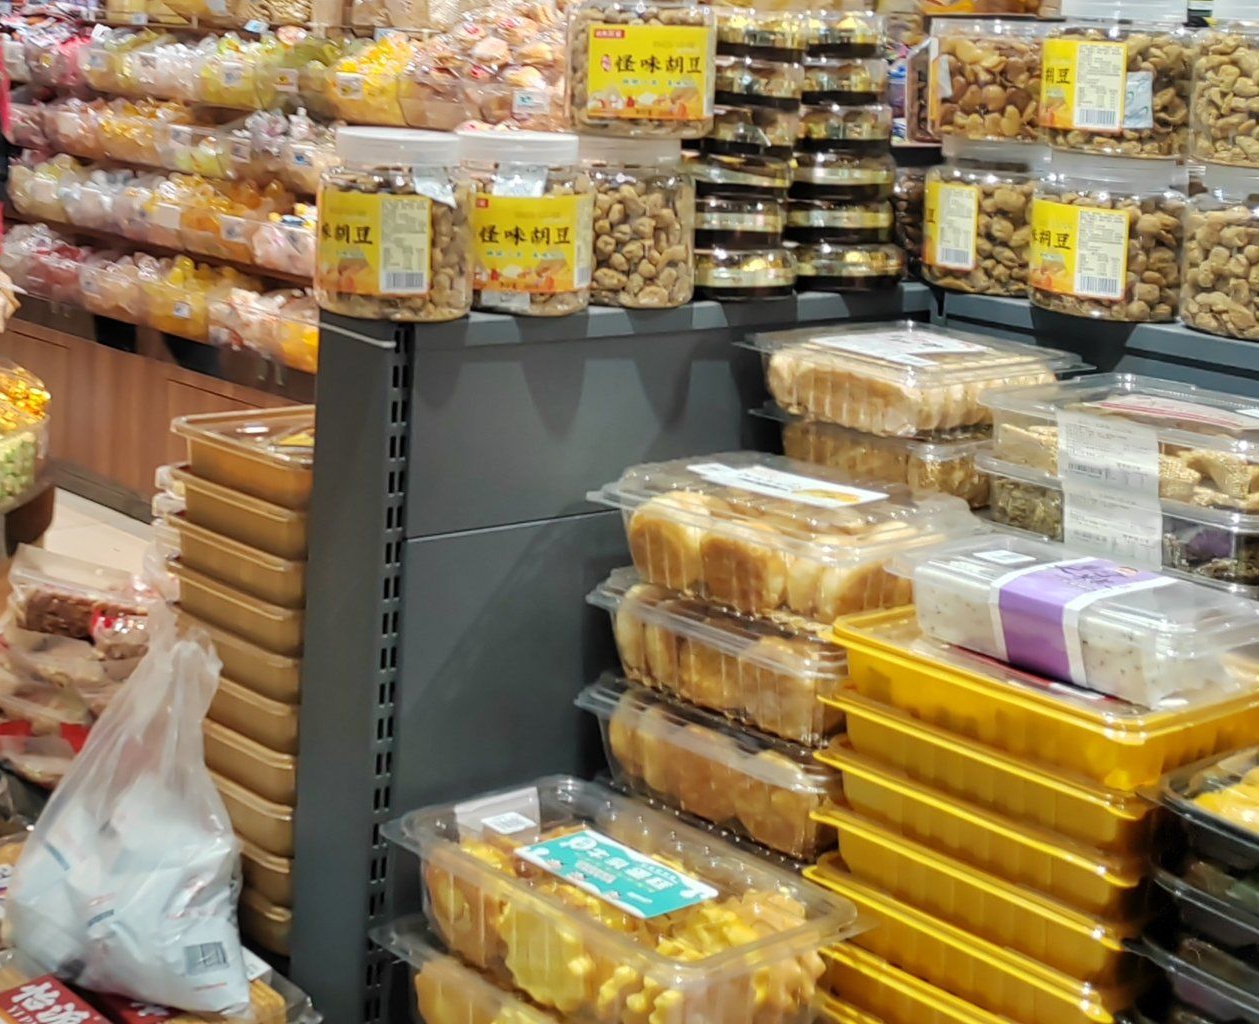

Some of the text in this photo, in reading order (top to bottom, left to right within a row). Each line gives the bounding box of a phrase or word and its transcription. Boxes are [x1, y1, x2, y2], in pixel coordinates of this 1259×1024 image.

[615, 53, 703, 74] 怪味胡豆
[478, 223, 572, 246] 怪味胡豆
